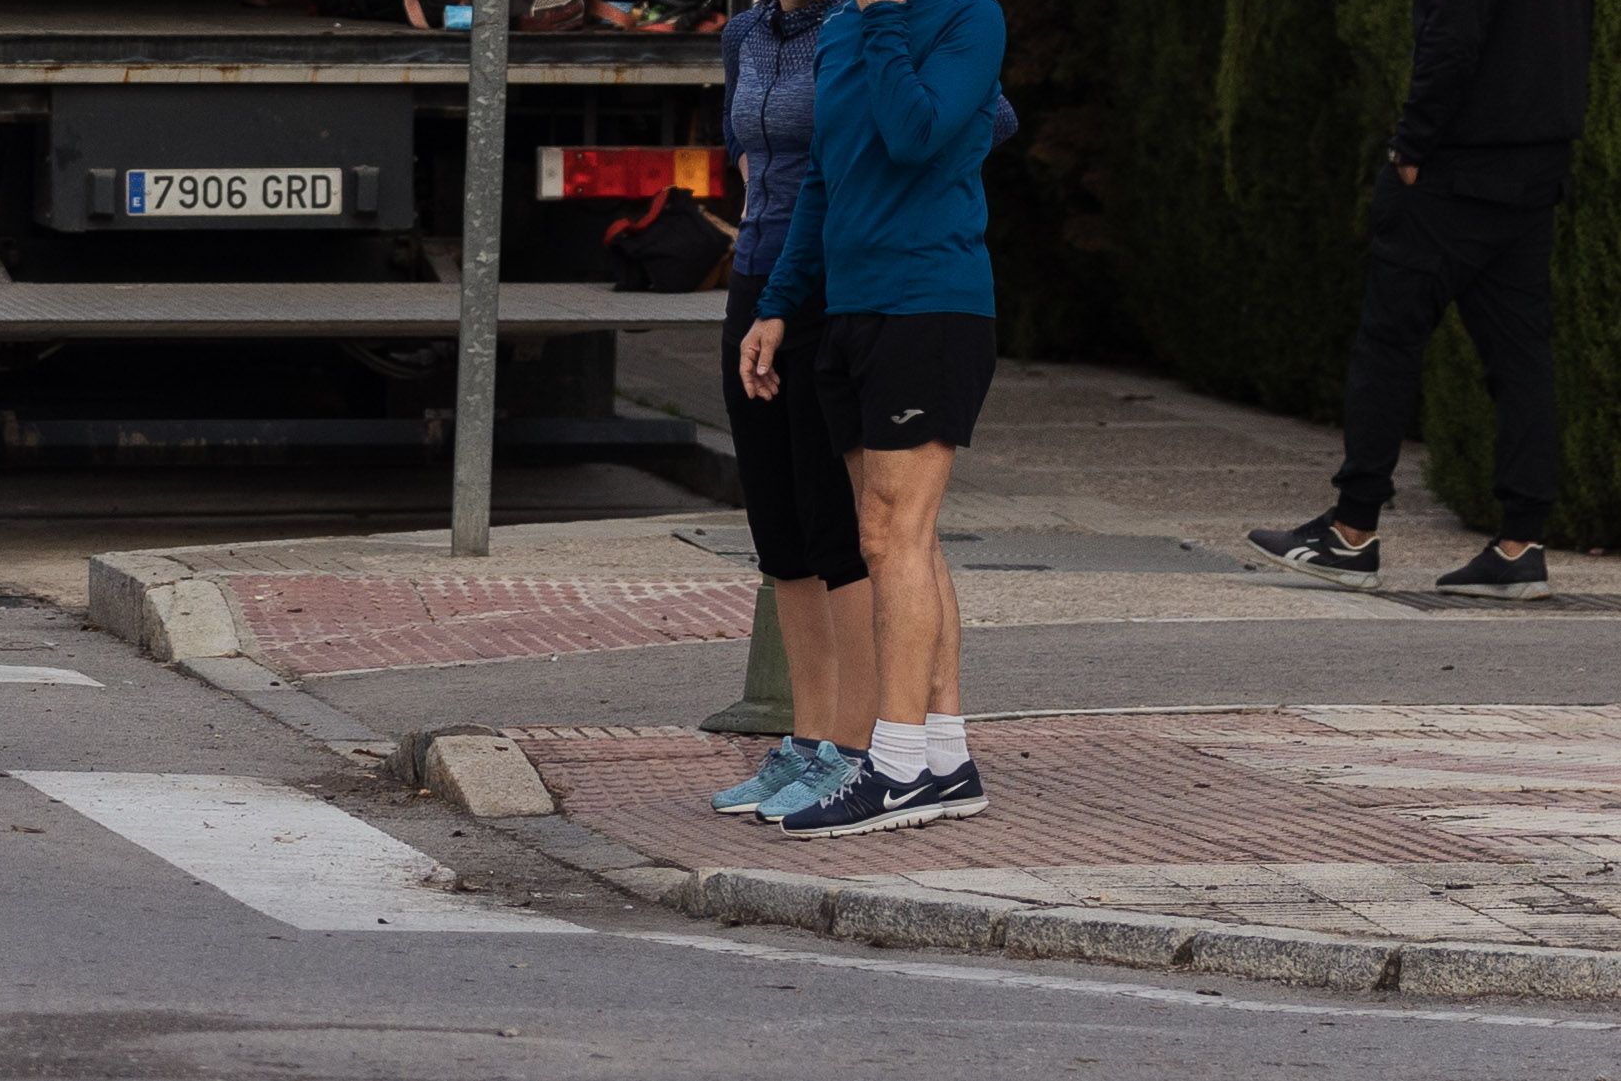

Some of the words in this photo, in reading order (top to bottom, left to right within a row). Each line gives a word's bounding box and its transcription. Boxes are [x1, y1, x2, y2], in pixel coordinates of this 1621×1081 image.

[132, 196, 142, 208] E
[153, 174, 248, 210] 7906
[262, 174, 332, 209] GRD
